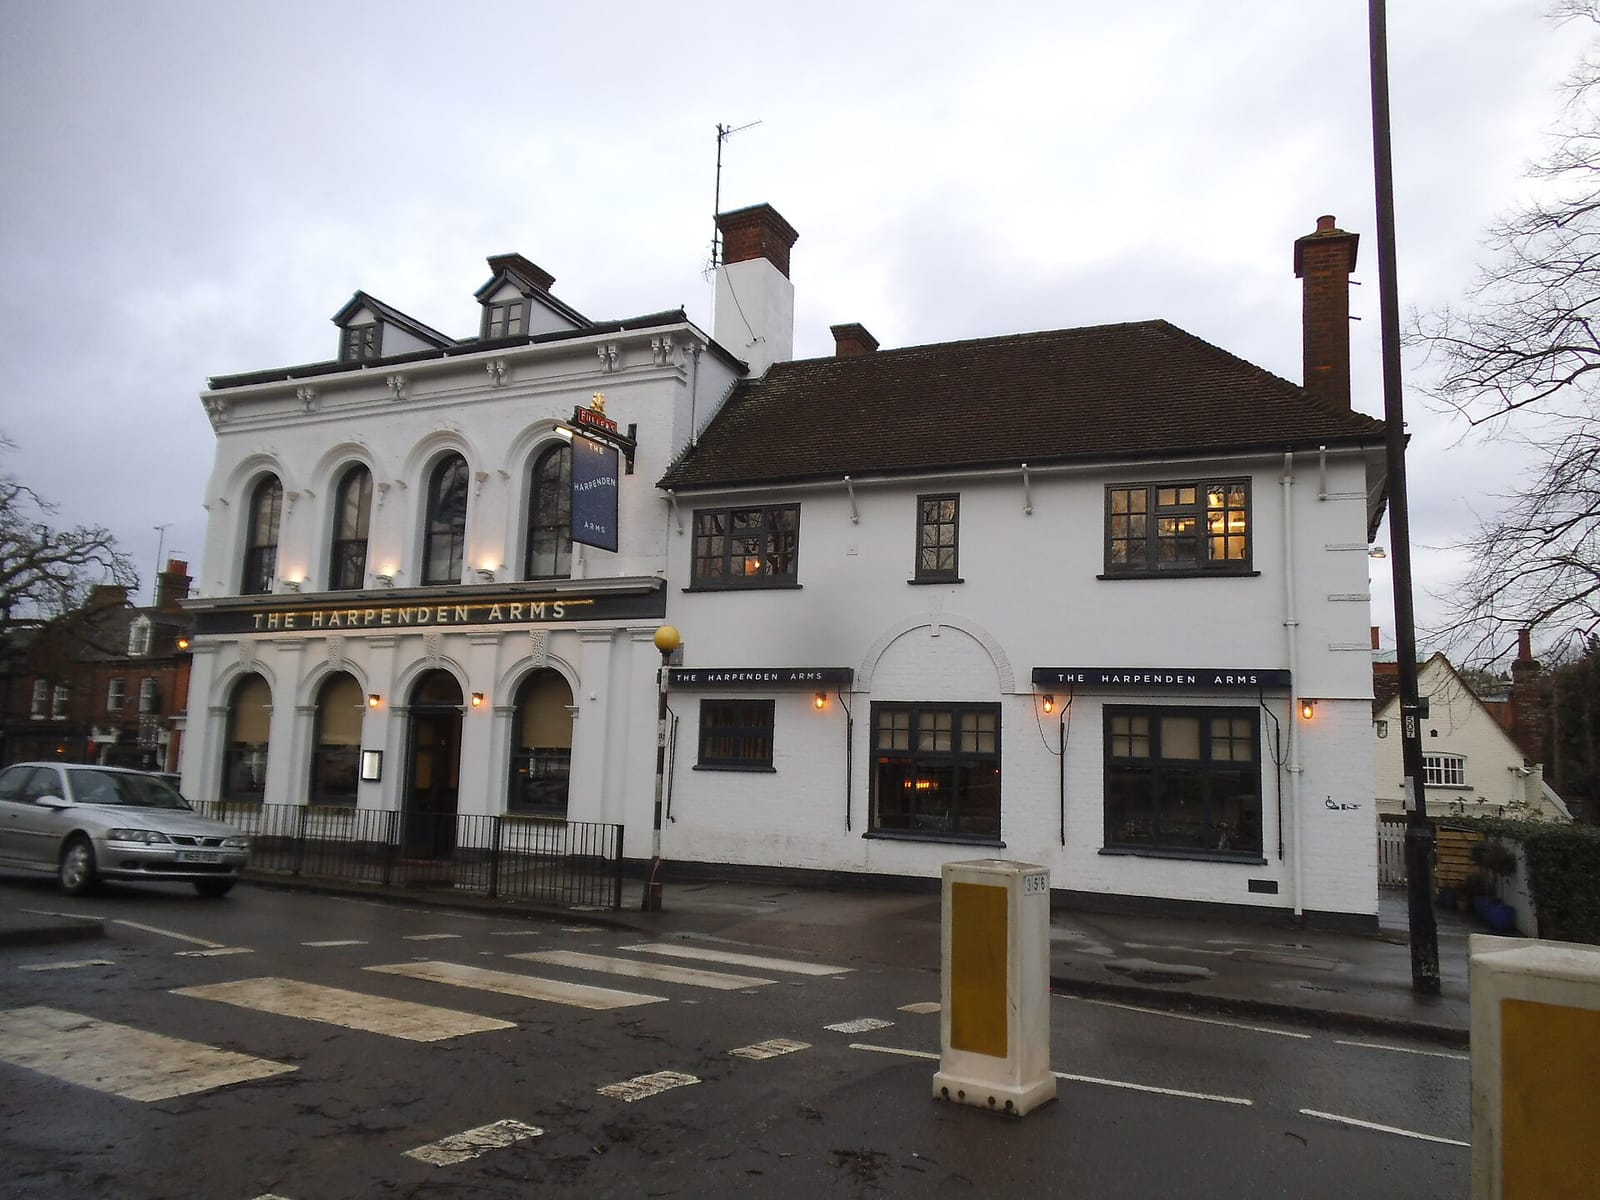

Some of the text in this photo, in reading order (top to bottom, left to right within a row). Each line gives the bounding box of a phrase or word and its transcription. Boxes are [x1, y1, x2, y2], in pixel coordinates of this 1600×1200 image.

[588, 443, 604, 455] THE
[574, 477, 616, 492] HARPENDEN
[584, 521, 605, 534] ARMS
[253, 601, 566, 629] THE HARPENDEN ARMS
[676, 672, 822, 682] THE HARPENDEN ARMS
[1058, 674, 1257, 684] THE HARPENDEN ARMS
[1026, 876, 1046, 892] 356
